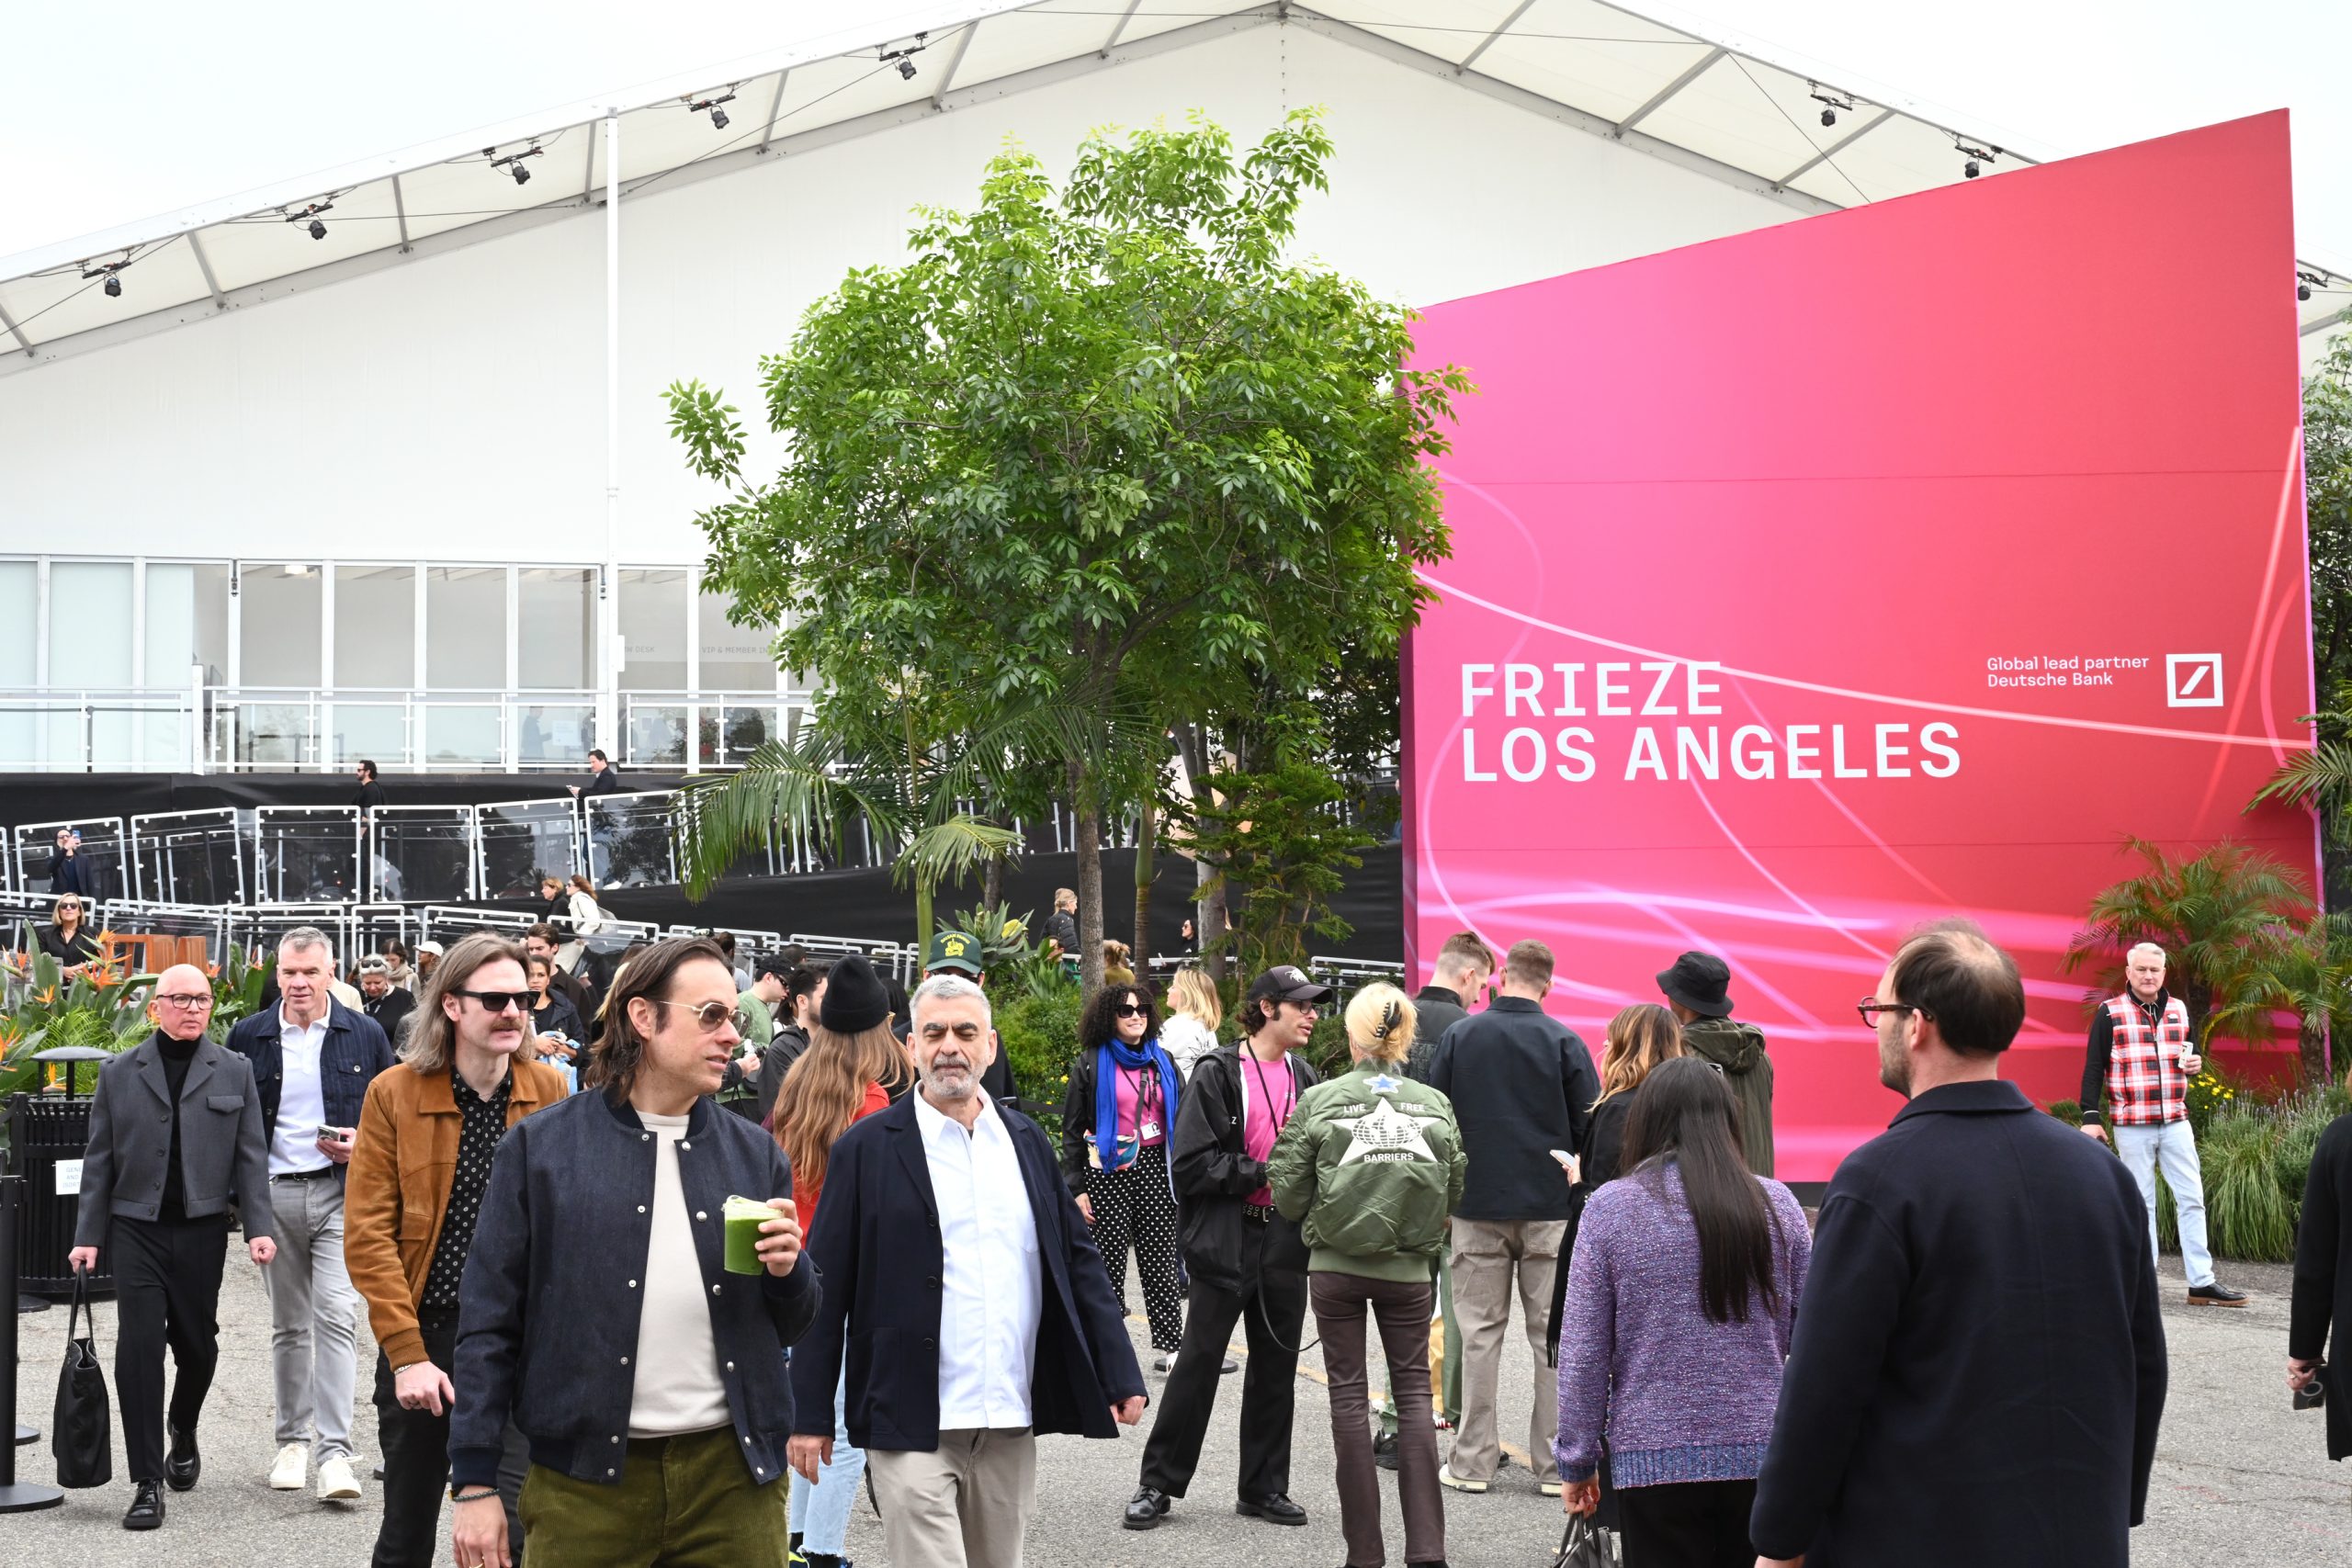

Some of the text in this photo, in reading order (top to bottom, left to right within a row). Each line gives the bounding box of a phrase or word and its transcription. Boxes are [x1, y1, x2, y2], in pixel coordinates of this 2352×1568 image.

[725, 646, 756, 654] MEMBER
[1987, 655, 2151, 672] Global lead partner
[1462, 660, 1724, 716] FRIEZE
[1987, 671, 2114, 688] Deutsche Bank
[1463, 722, 1961, 783] LOS ANGELES
[1343, 1102, 1426, 1113] LIVE FREE
[1363, 1152, 1414, 1162] BARRIERS
